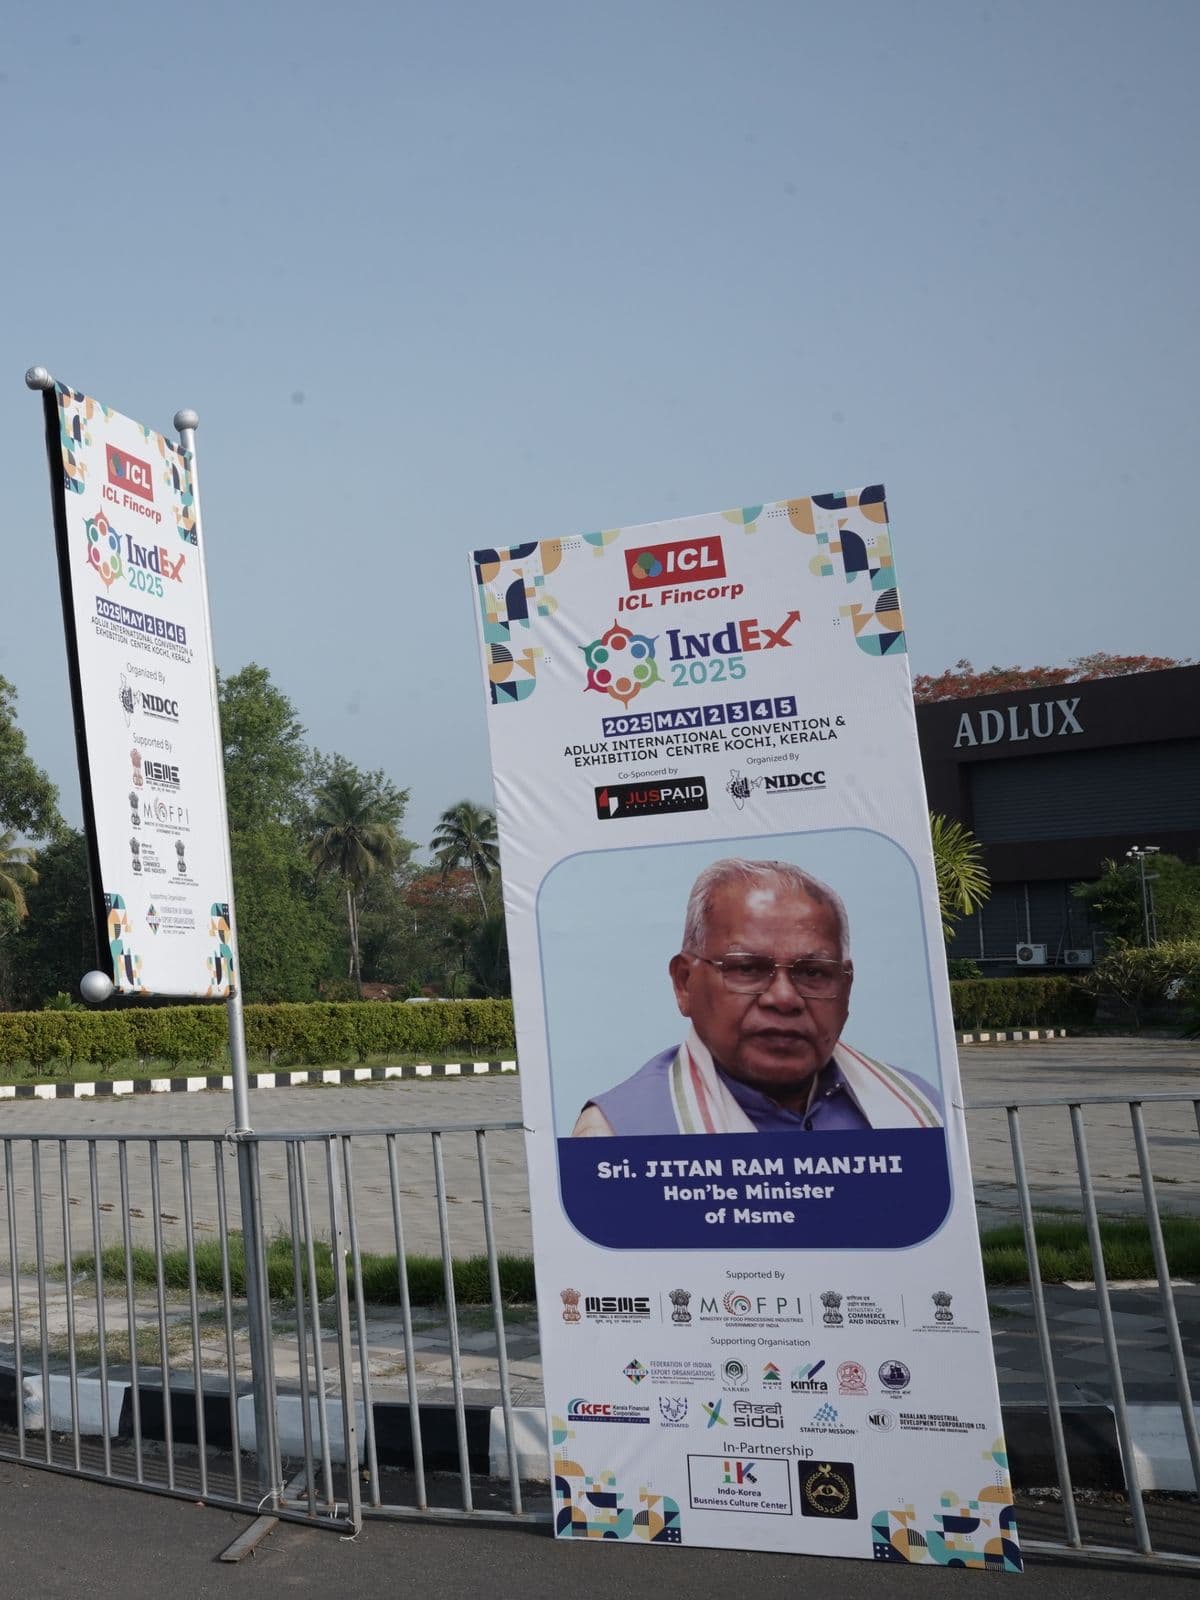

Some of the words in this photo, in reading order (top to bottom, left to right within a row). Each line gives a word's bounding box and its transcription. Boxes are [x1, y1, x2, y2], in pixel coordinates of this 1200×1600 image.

[125, 461, 150, 489] ICL
[102, 484, 121, 505] ICL
[123, 493, 162, 525] Fincorp
[666, 547, 719, 573] ICL
[128, 567, 164, 599] 2025
[617, 592, 654, 612] ICL
[660, 582, 744, 606] Fincorp
[97, 599, 121, 620] 2025
[122, 608, 143, 629] MAY
[671, 656, 747, 687] 2025
[141, 692, 178, 717] NIDCC
[605, 715, 653, 736] 2025
[657, 709, 700, 730] MAY
[708, 708, 721, 724] 2
[732, 705, 744, 721] 3
[754, 702, 769, 718] 4
[780, 699, 792, 715] 5
[953, 698, 1084, 748] ADLUX
[564, 742, 609, 757] ADLUX
[612, 729, 727, 751] INTERNATIONAL
[730, 718, 830, 738] CONVENTION
[835, 715, 847, 727] &
[574, 748, 659, 768] EXHIBITION
[666, 741, 721, 758] CENTRE
[724, 735, 777, 751] KOCHI,
[779, 729, 838, 746] KERALA
[746, 754, 788, 766] Organized
[789, 752, 800, 762] By
[668, 767, 678, 775] by
[764, 770, 826, 789] NIDCC
[626, 785, 705, 804] JUSPAID
[597, 1161, 638, 1180] Sri.
[645, 1159, 722, 1178] JITAN
[732, 1157, 785, 1176] RAM
[794, 1155, 903, 1176] MANJHI
[746, 1182, 834, 1200] Minister
[705, 1208, 727, 1224] of
[733, 1208, 795, 1224] Msme
[726, 1270, 772, 1282] Supported
[775, 1270, 785, 1281] By
[586, 1297, 650, 1313] MSME
[710, 1336, 756, 1347] Supporting
[757, 1337, 811, 1347] Organisation
[650, 1360, 682, 1368] FEDERATION
[581, 1404, 611, 1416] KFC
[734, 1415, 784, 1428] sidbi
[938, 1421, 975, 1429] CORPORATION
[723, 1441, 814, 1459] In-Partnership
[717, 1488, 761, 1497] Indo-Korea
[729, 1499, 758, 1509] Culture
[760, 1501, 787, 1510] Center
